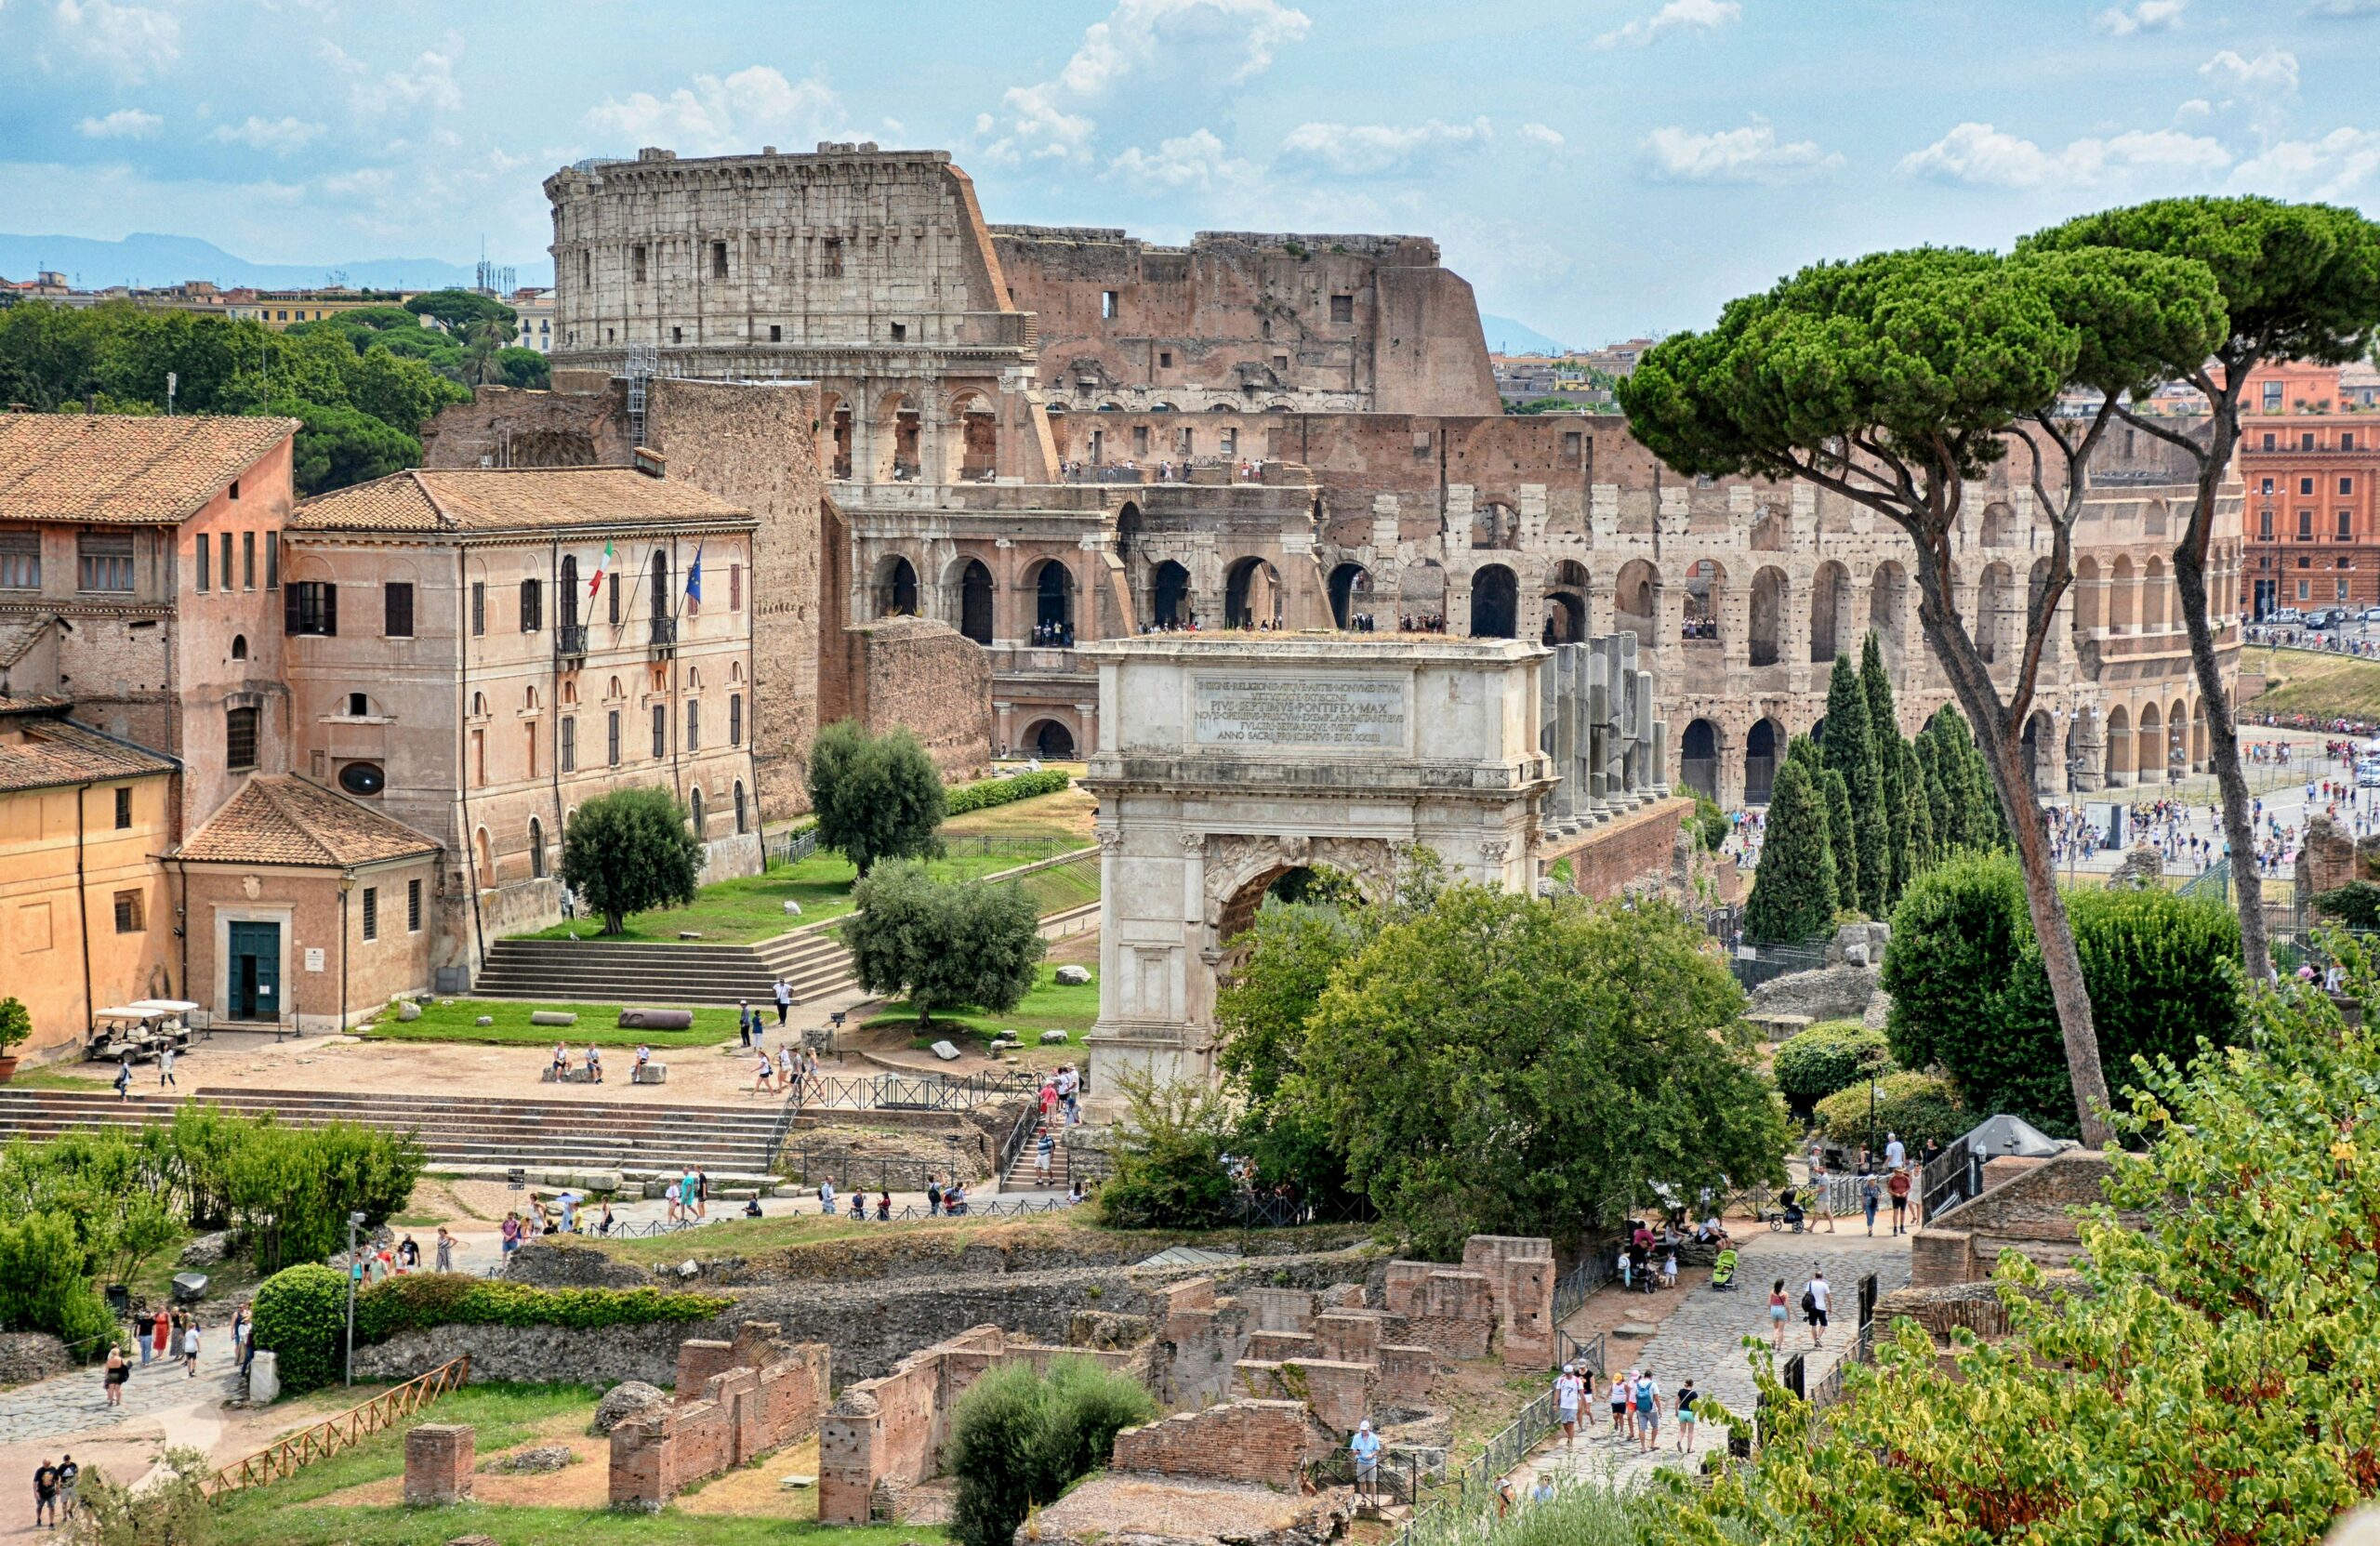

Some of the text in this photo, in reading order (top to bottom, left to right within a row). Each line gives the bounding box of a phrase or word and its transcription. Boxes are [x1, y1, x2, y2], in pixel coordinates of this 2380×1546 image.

[1233, 681, 1277, 691] RELIGIONIS
[1210, 700, 1387, 714] PIVS SEPTIMVS PONTIFEX MAX
[1302, 713, 1347, 722] EXEMPLAR
[1217, 731, 1245, 740] ANNO
[1248, 731, 1274, 741] SACRI
